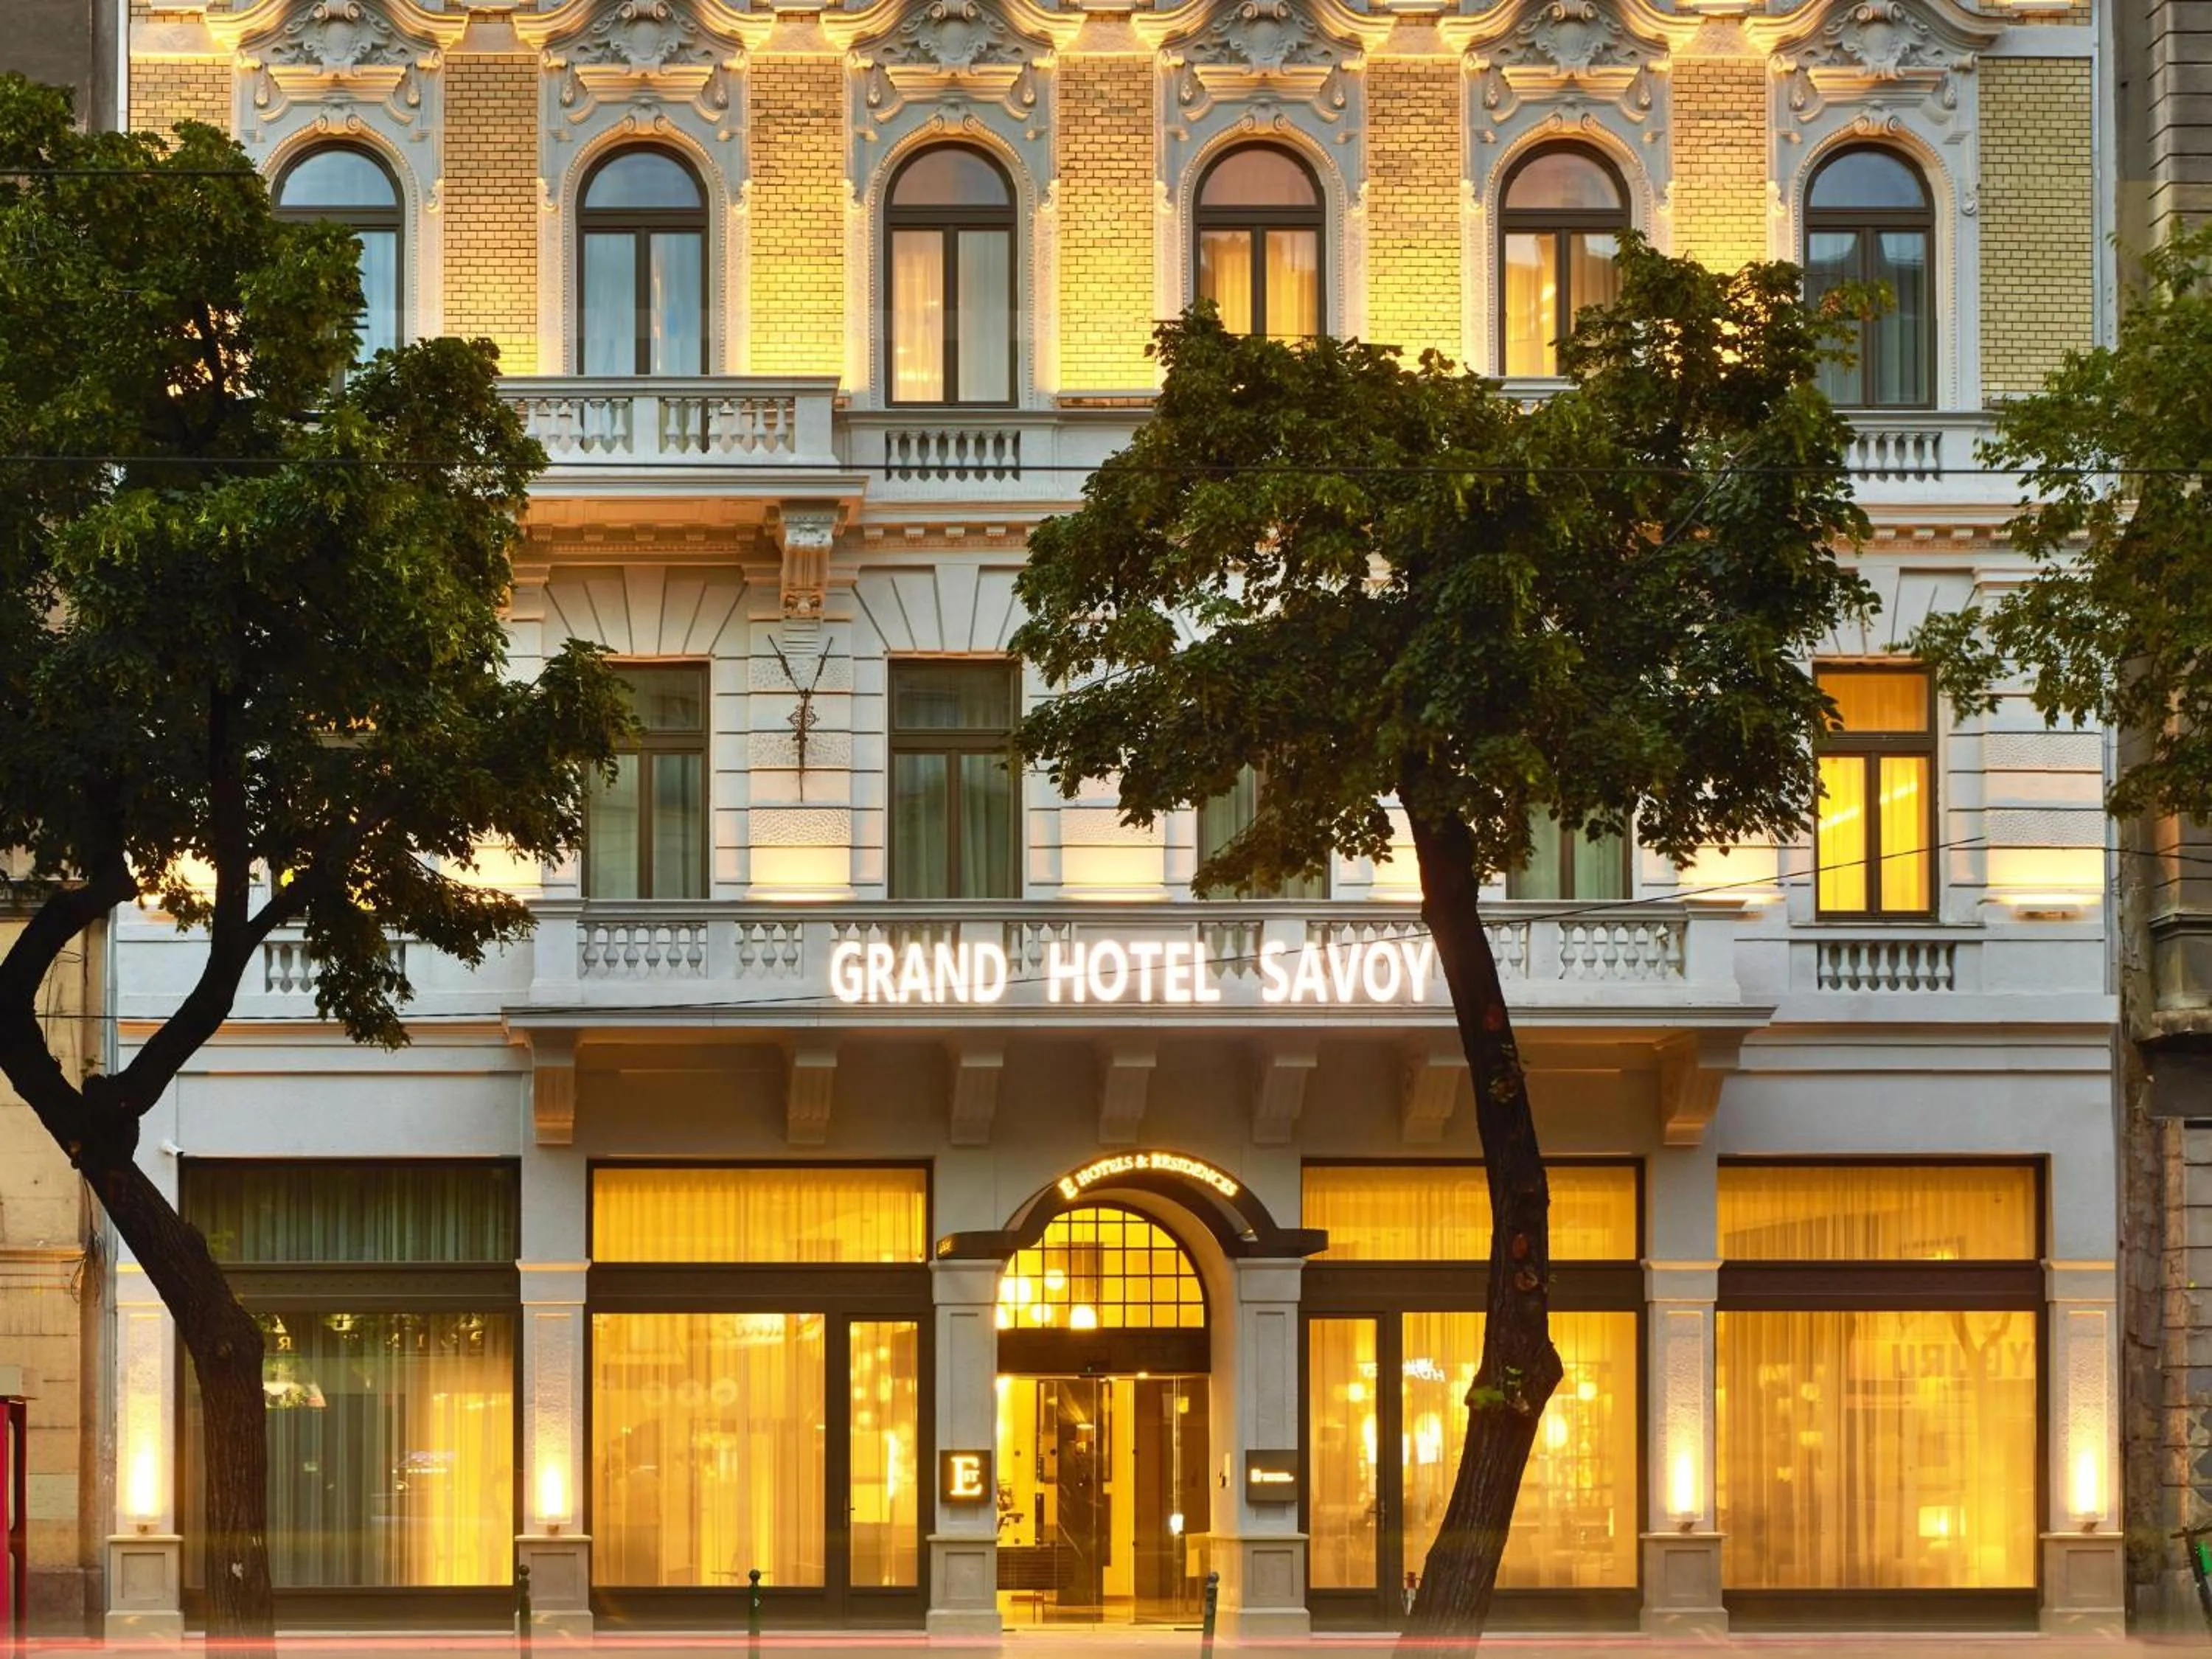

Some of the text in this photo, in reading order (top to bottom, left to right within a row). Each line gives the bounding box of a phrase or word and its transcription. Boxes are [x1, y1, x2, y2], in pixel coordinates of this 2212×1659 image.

[830, 939, 1434, 1004] GRAND HOTEL SAVOY
[1076, 1155, 1133, 1187] HOTELS
[1151, 1152, 1238, 1196] RESIDENCES
